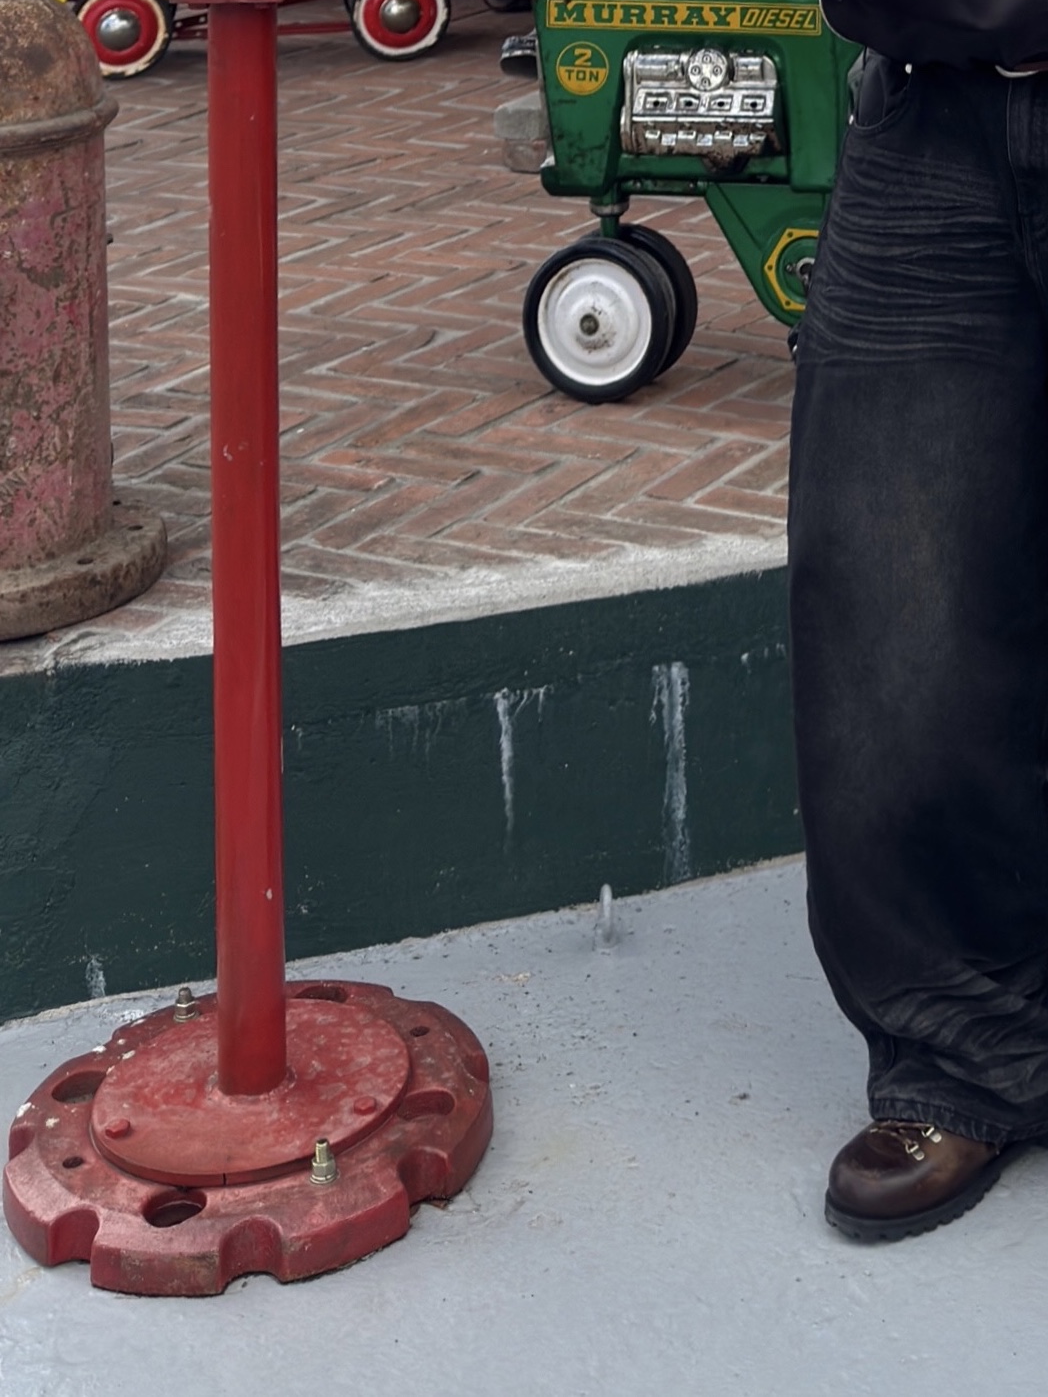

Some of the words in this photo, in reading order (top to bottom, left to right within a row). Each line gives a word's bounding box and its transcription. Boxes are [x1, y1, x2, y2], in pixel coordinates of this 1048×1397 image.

[554, 2, 737, 27] MURRAY
[741, 8, 816, 29] DIESEL
[574, 48, 592, 66] 2
[565, 69, 600, 82] TON
